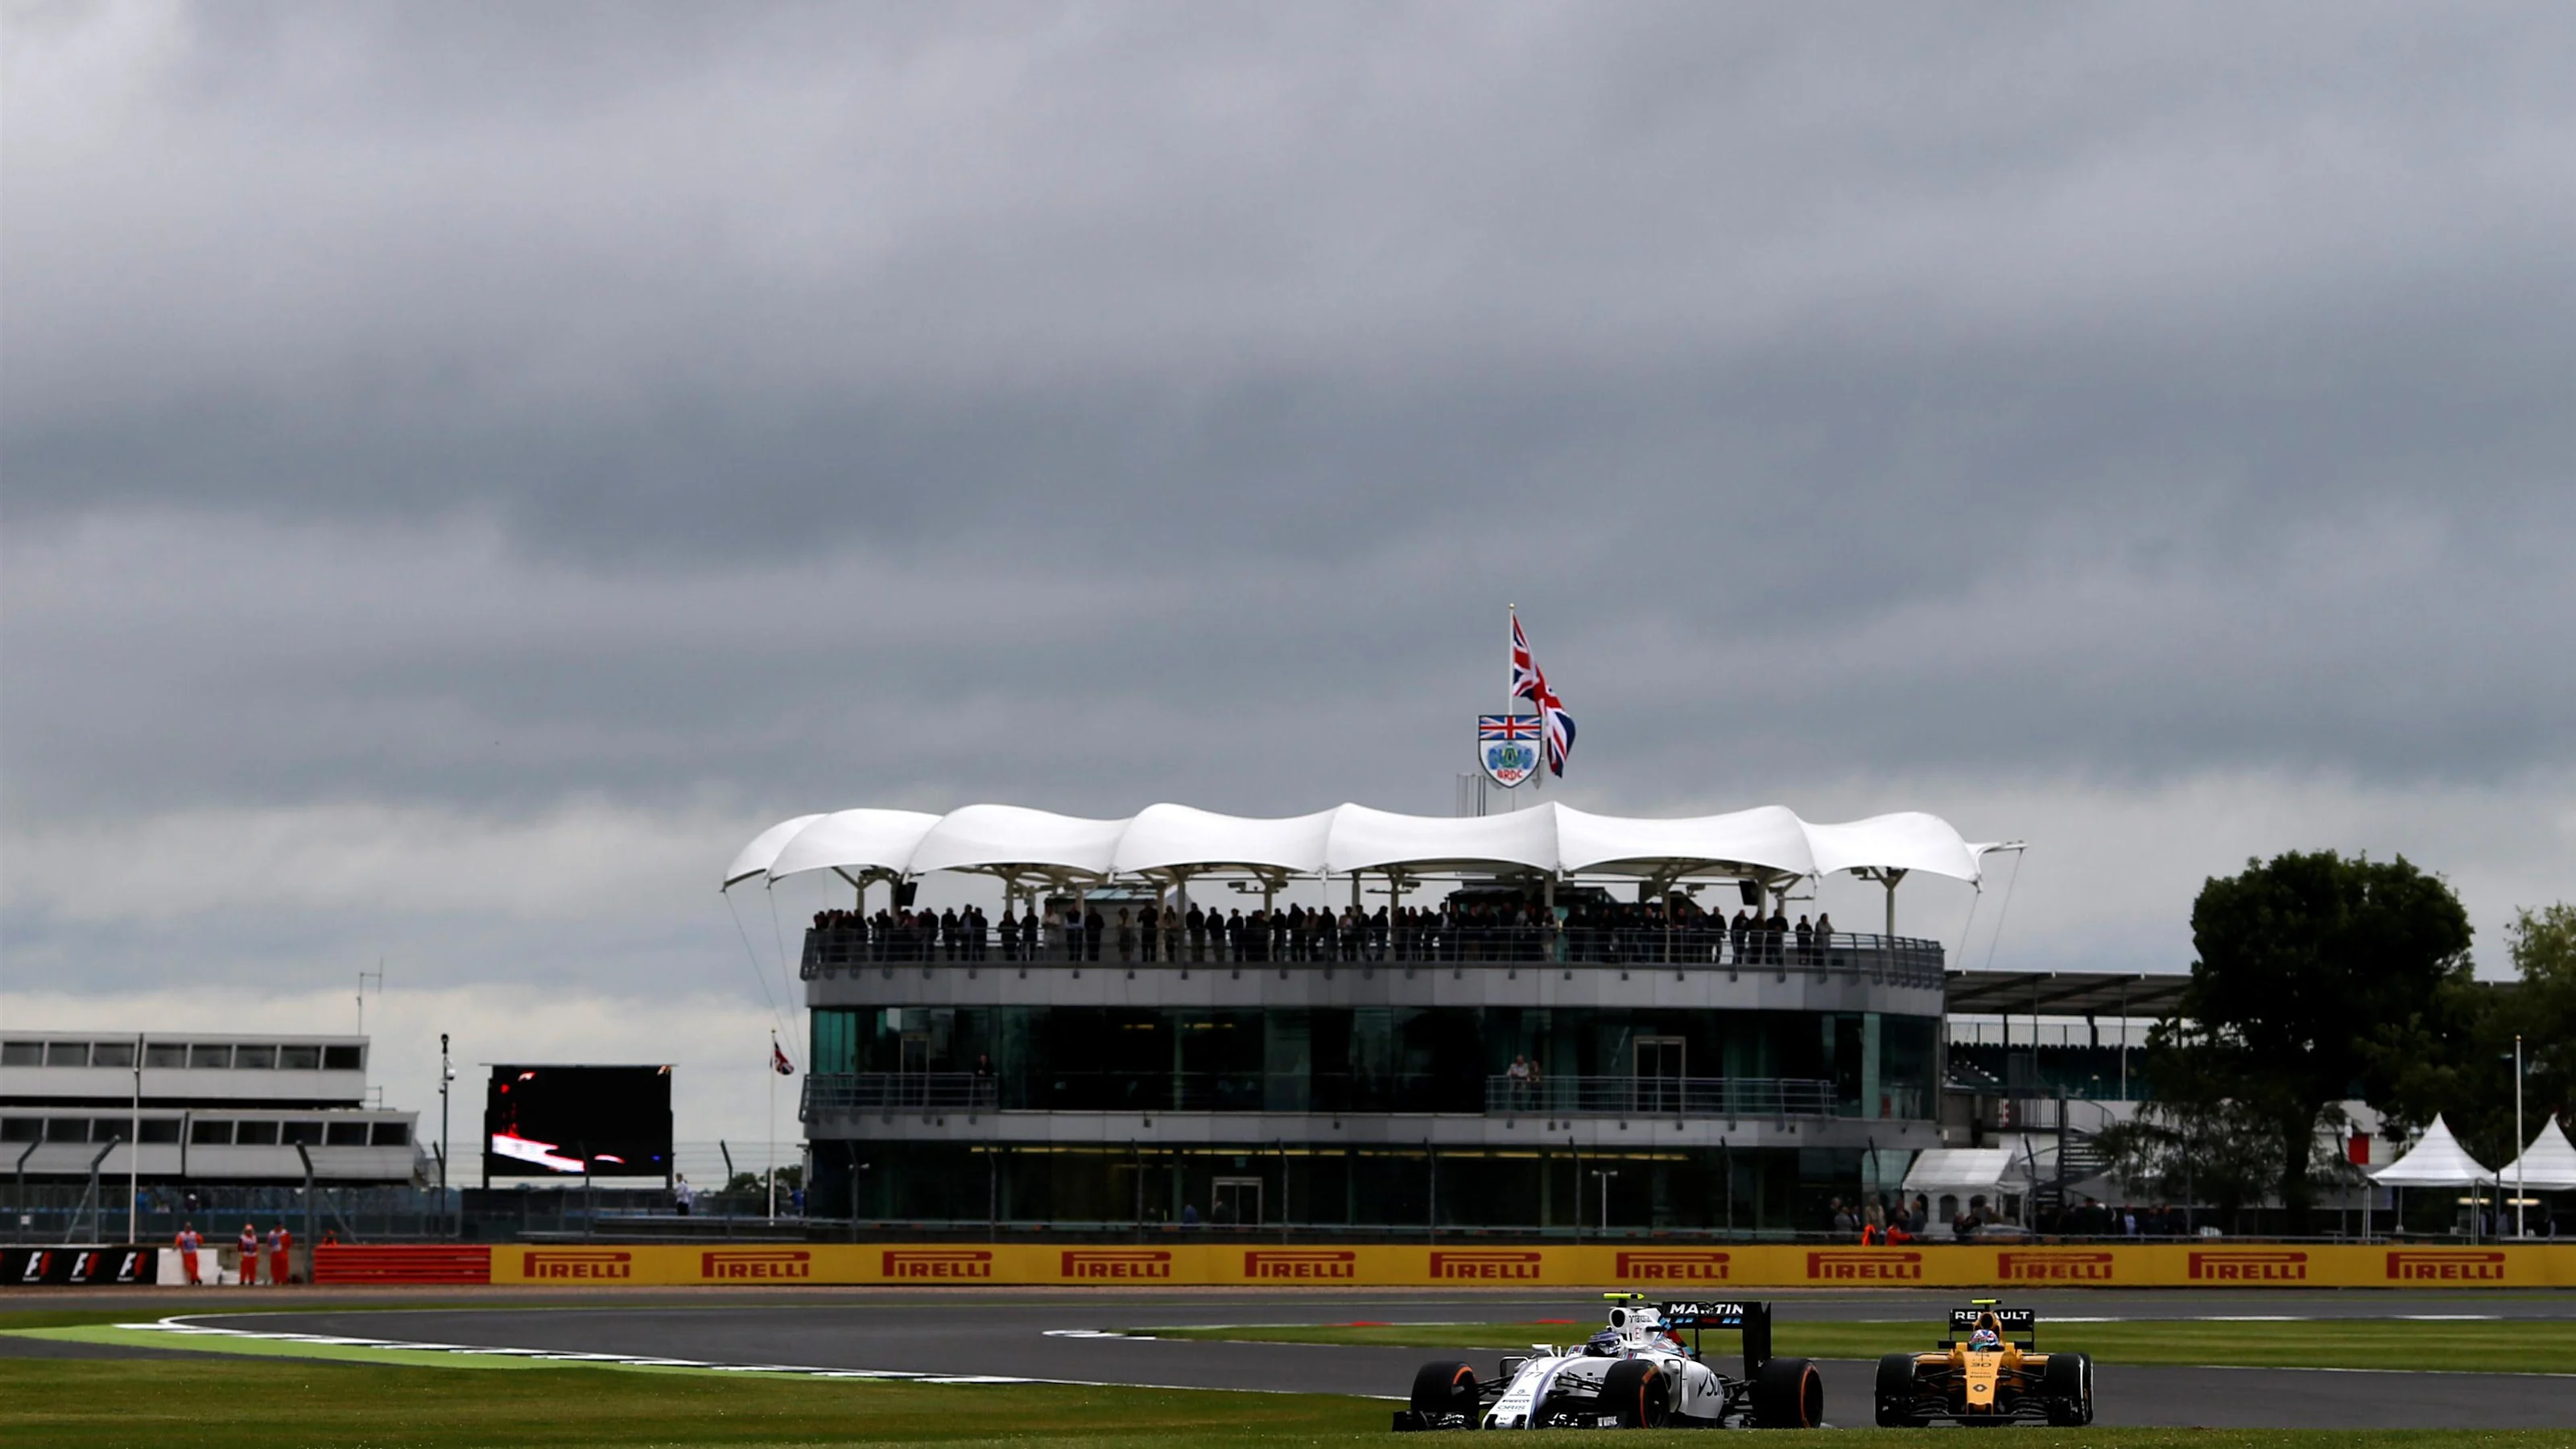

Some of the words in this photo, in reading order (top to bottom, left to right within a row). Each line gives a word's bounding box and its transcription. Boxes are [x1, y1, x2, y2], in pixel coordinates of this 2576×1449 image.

[525, 1253, 632, 1278] PIRELLI
[704, 1253, 811, 1278] PIRELLI
[884, 1253, 993, 1278] PIRELLI
[1063, 1252, 1171, 1278] PIRELLI
[1246, 1252, 1356, 1278] PIRELLI
[1431, 1252, 1542, 1278] PIRELLI
[1617, 1253, 1730, 1279] PIRELLI
[1808, 1253, 1922, 1279] PIRELLI
[1999, 1253, 2113, 1280] PIRELLI
[2190, 1253, 2308, 1280] PIRELLI
[2388, 1253, 2505, 1280] PIRELLI
[1670, 1303, 1744, 1315] MATIN
